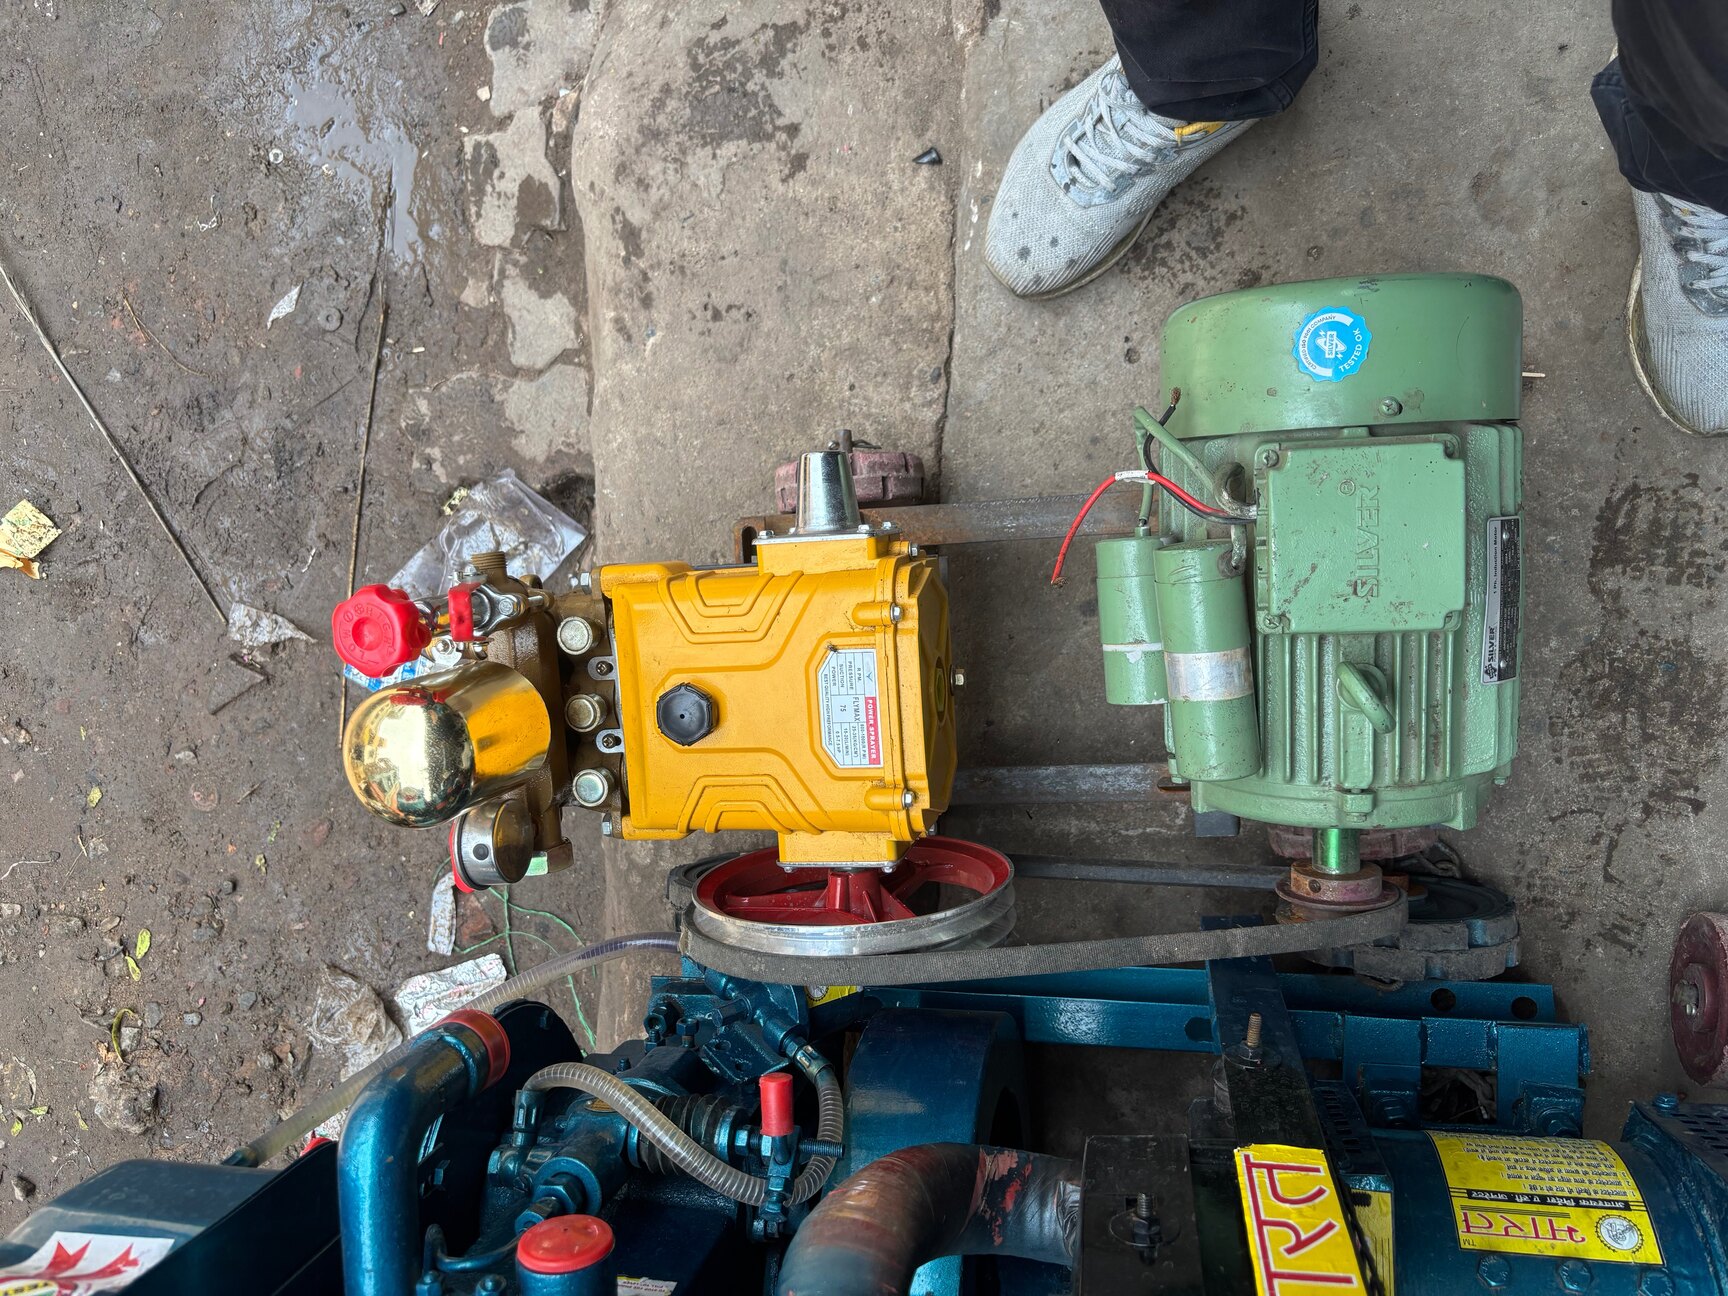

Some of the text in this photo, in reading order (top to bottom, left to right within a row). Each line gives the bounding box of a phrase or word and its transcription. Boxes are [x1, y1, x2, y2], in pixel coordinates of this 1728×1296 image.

[1310, 315, 1336, 329] COMPANY
[1327, 333, 1335, 356] SILVER
[1339, 327, 1363, 372] TESTED OK
[1356, 485, 1380, 597] SILVER
[847, 660, 855, 690] PRESSURE
[840, 704, 847, 712] 75
[852, 696, 861, 722] FLYMAX
[867, 699, 877, 759] POWER SPRAYER
[1471, 1190, 1508, 1201] जनरेटर
[1546, 1195, 1577, 1207] निर्देश
[1578, 1199, 1625, 1208] आवश्यक
[1461, 1211, 1586, 1243] भारत
[1462, 1239, 1477, 1247] TM
